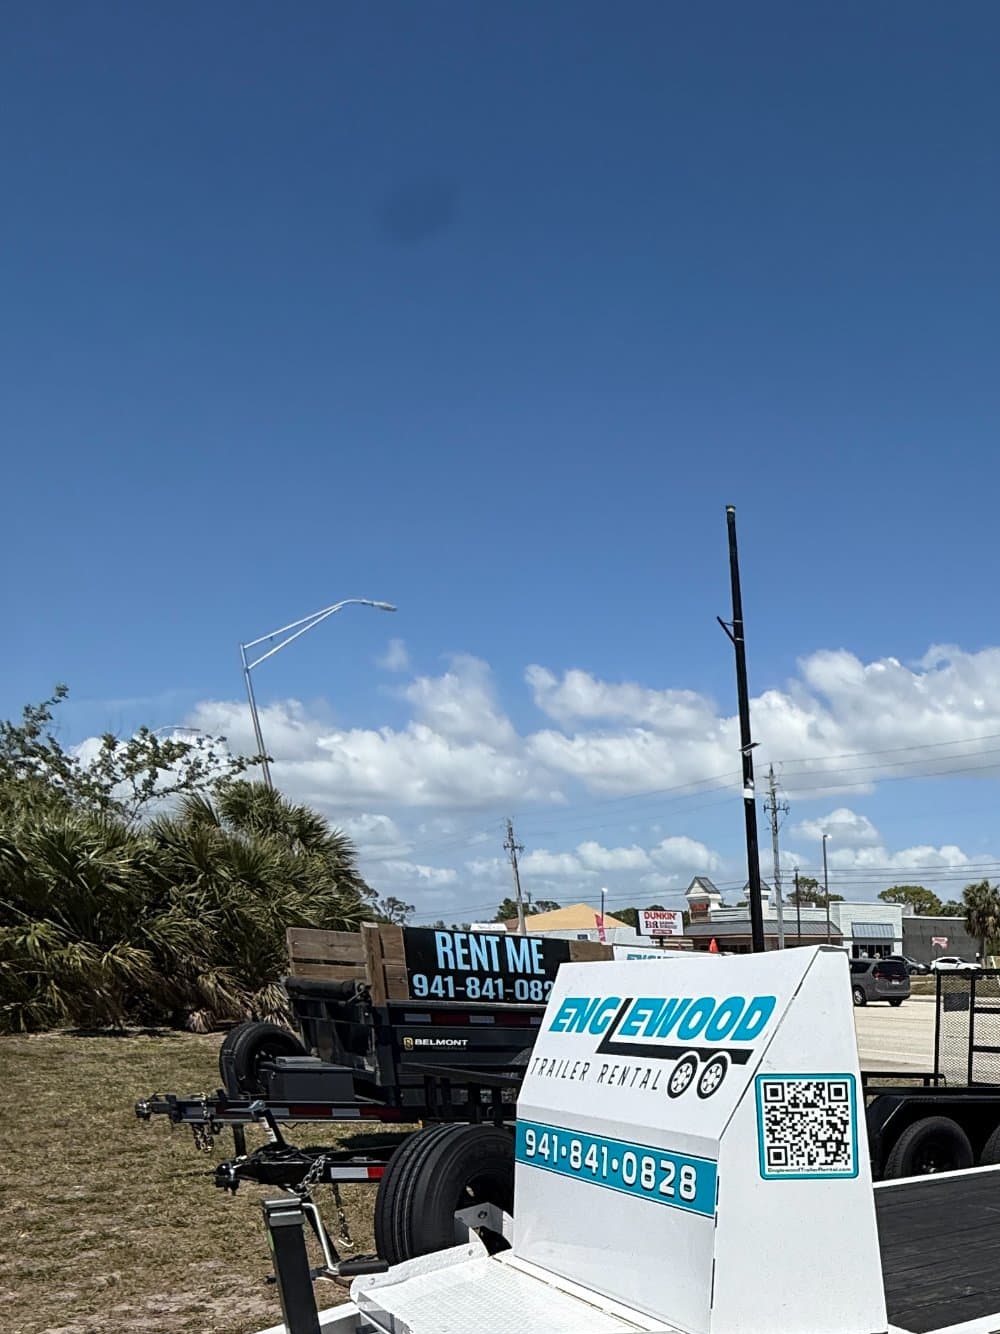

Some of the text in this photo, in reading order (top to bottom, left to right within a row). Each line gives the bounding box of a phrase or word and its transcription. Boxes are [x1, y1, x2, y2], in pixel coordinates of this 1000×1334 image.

[436, 931, 546, 975] RENT ME
[413, 973, 554, 1001] 941-841-082
[549, 996, 777, 1045] ENGLEWOOD
[414, 1038, 469, 1046] BELMONT
[530, 1057, 662, 1092] TRAILER RENTAL
